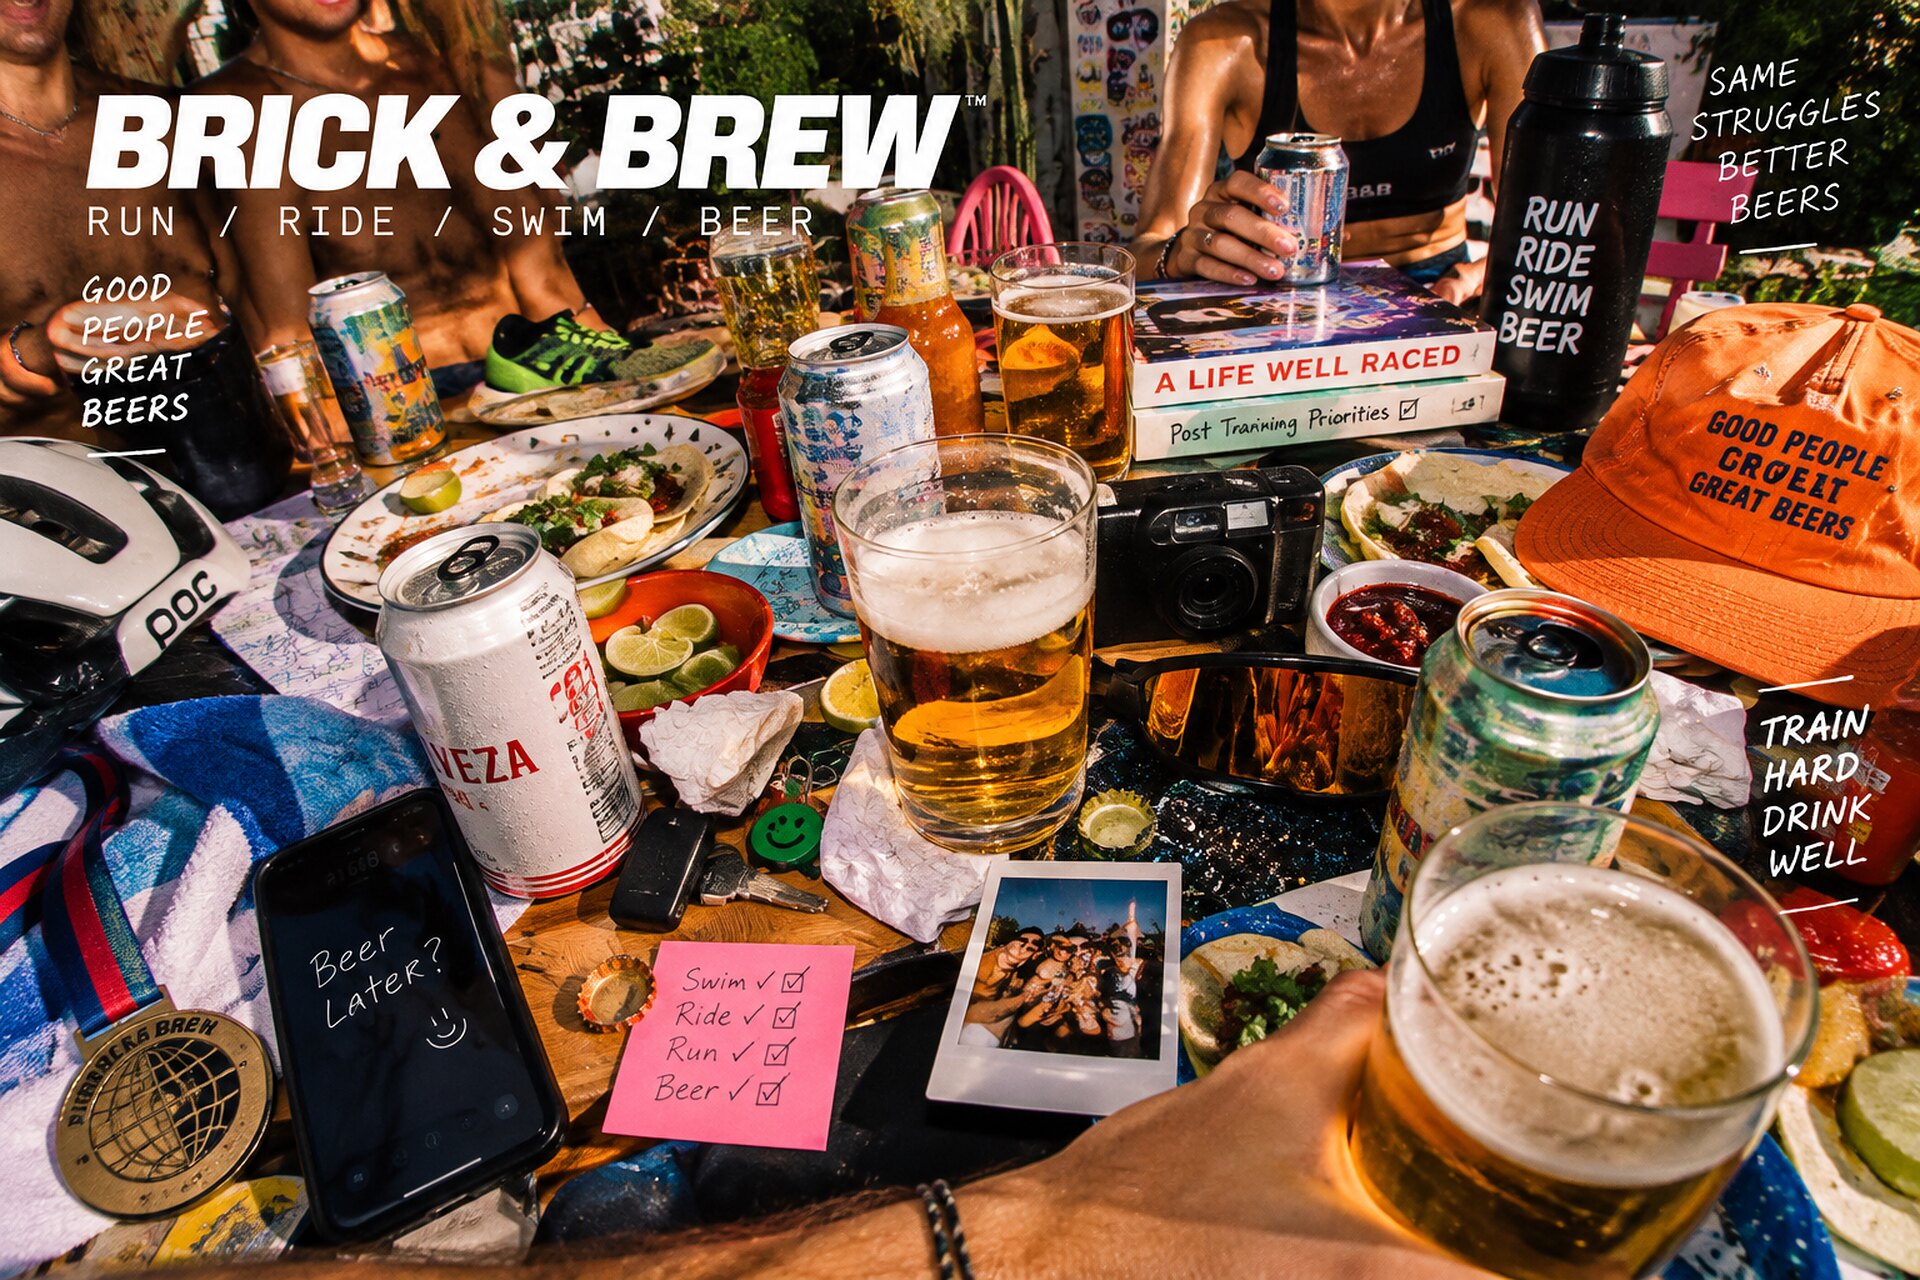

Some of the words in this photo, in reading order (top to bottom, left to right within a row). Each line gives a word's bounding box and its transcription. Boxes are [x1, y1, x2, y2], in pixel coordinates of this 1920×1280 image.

[1523, 195, 1600, 237] RUN
[1515, 236, 1596, 278] RIDE
[1506, 275, 1594, 317] SWIM
[1499, 311, 1583, 356] BEER
[1155, 372, 1176, 394] A
[1188, 364, 1255, 391] LIFE
[1267, 358, 1349, 383] WELL
[1361, 345, 1461, 374] RACED
[1170, 422, 1212, 445] Post
[1308, 405, 1390, 430] Priorities
[1707, 410, 1779, 447] GOOD
[1781, 430, 1890, 481] PEOPLE
[1688, 471, 1770, 513] GREAT
[1769, 496, 1855, 540] BEERS
[428, 739, 540, 784] VEZA
[309, 926, 395, 989] Beer
[682, 967, 746, 991] Swim
[675, 1001, 732, 1026] Ride
[666, 1035, 717, 1062] Run
[654, 1073, 719, 1101] Beer
